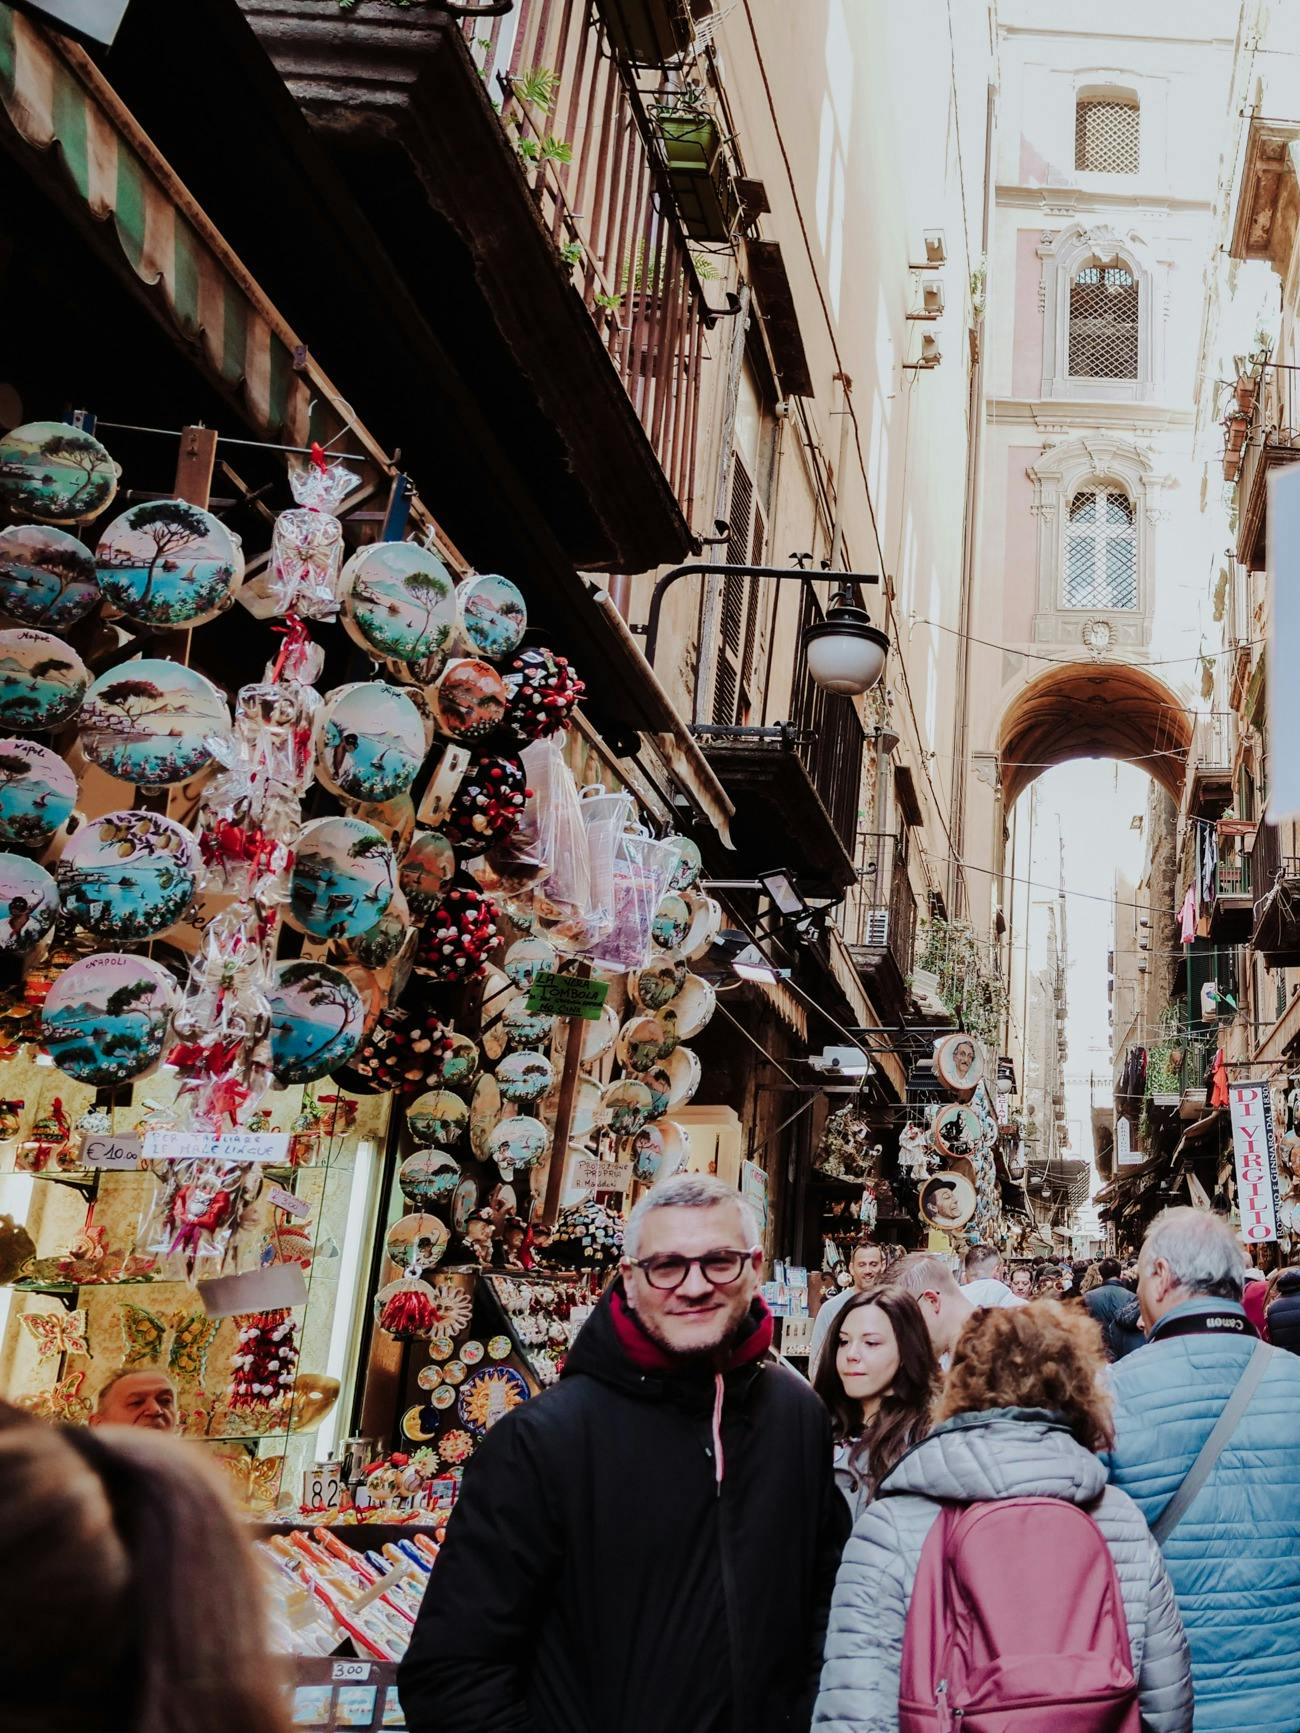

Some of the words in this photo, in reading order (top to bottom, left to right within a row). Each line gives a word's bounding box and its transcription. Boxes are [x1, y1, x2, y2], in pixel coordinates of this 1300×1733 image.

[542, 986, 599, 1002] TOMBOLA
[1236, 1088, 1259, 1117] DI
[579, 1160, 629, 1170] PROUZIONE
[1238, 1126, 1272, 1240] VIRGILIO
[1206, 1317, 1244, 1330] Canon
[311, 1480, 338, 1508] 82
[335, 1664, 363, 1677] 3.00
